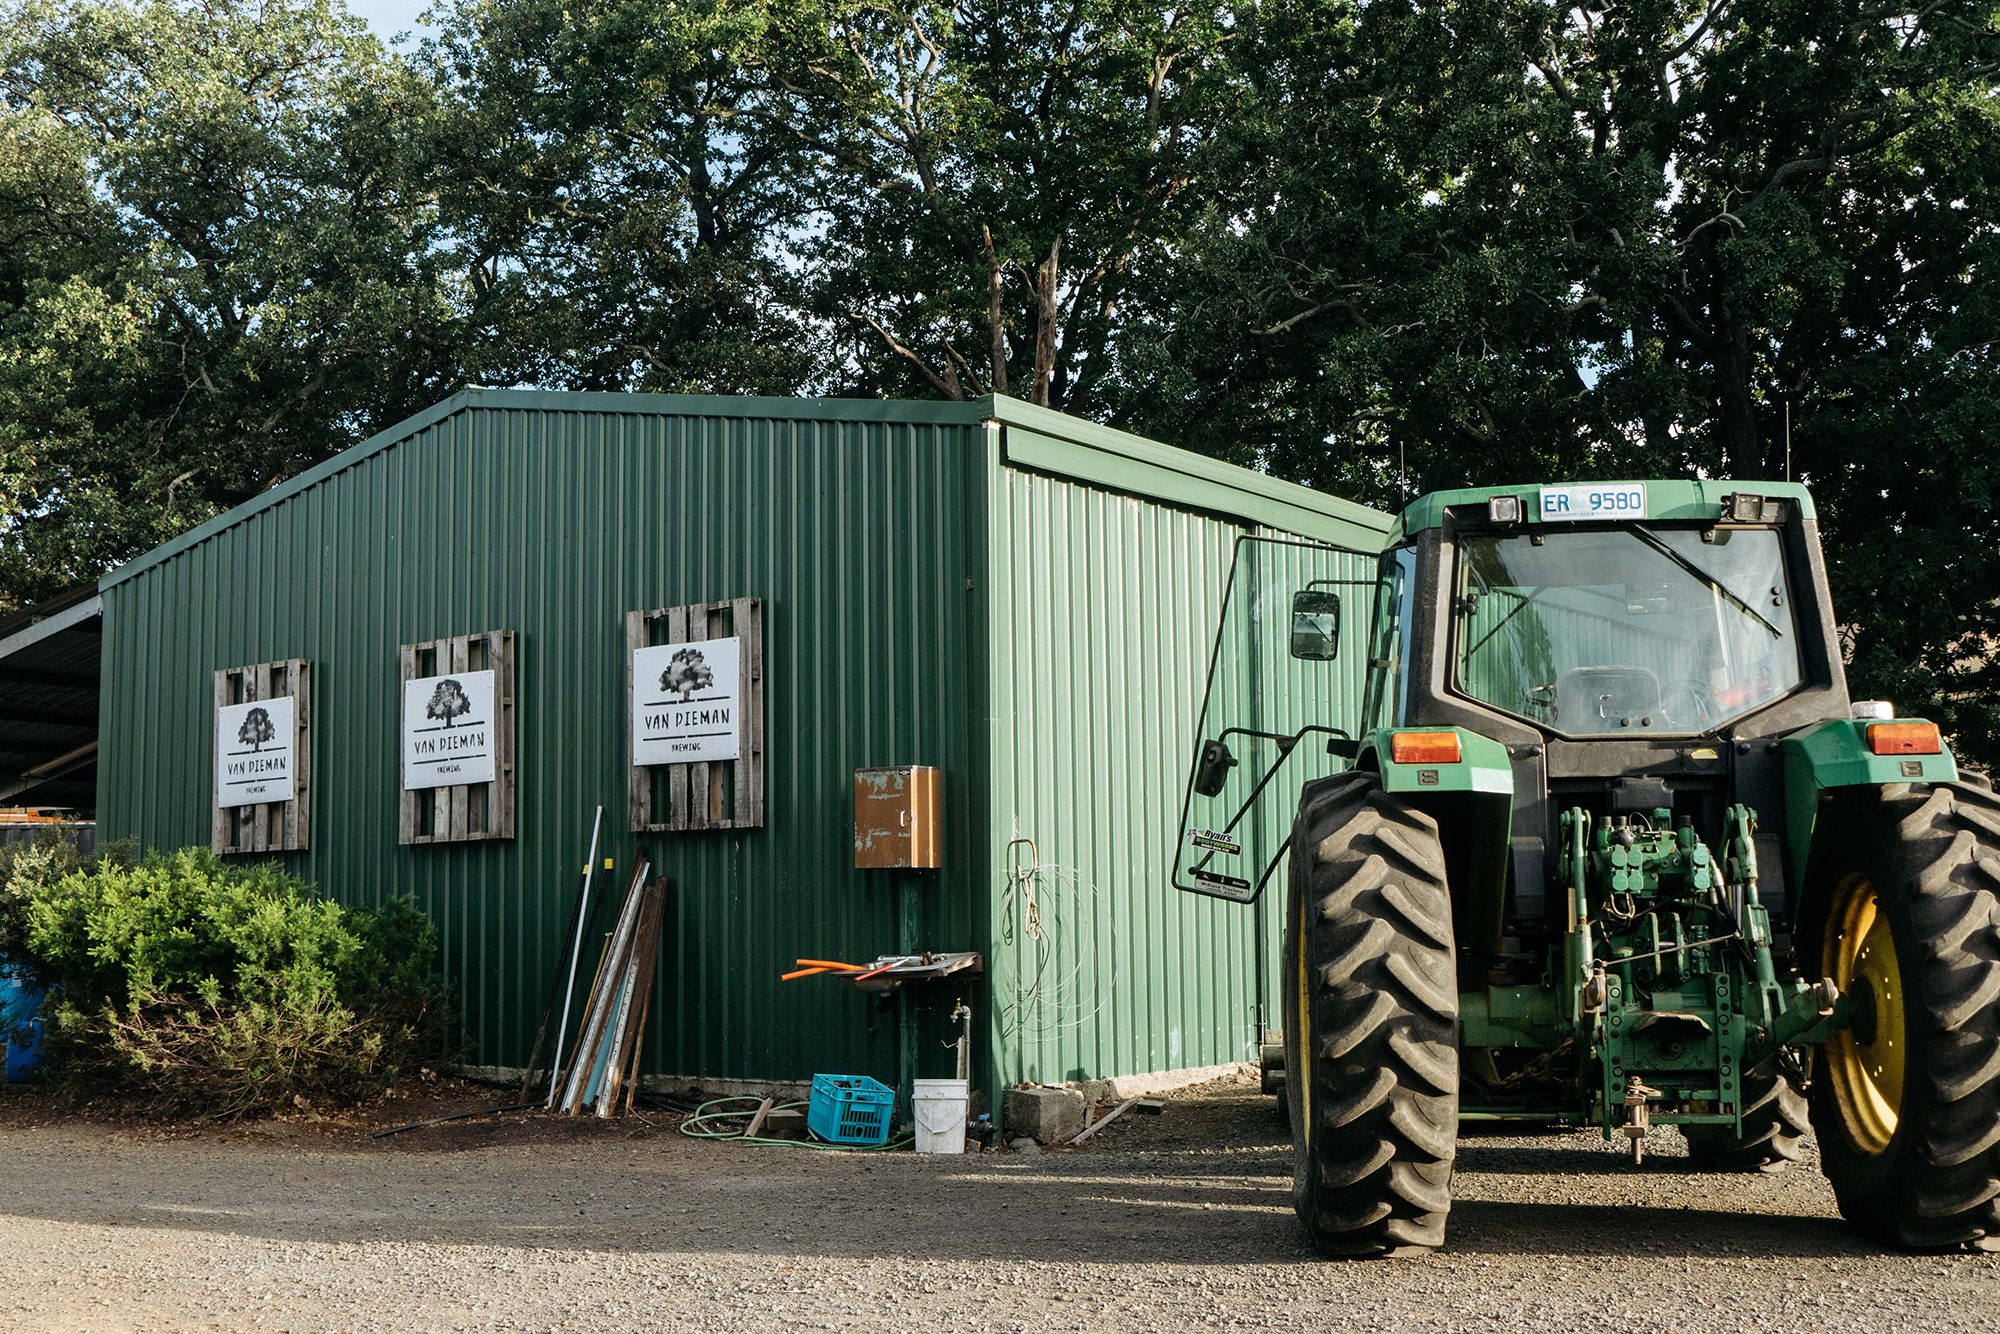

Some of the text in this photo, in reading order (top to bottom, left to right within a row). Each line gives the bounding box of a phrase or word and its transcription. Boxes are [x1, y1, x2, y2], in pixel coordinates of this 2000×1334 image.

[1544, 491, 1641, 512] ER 9580
[644, 707, 730, 730] VAN DIEMAN
[414, 731, 484, 754] VAN DIEMAN
[671, 742, 702, 752] BREWING
[227, 756, 286, 776] VAN DIEMAN
[436, 765, 461, 774] BREWING
[1196, 837, 1238, 851] BODYWORKS
[1204, 829, 1233, 843] Ryan's
